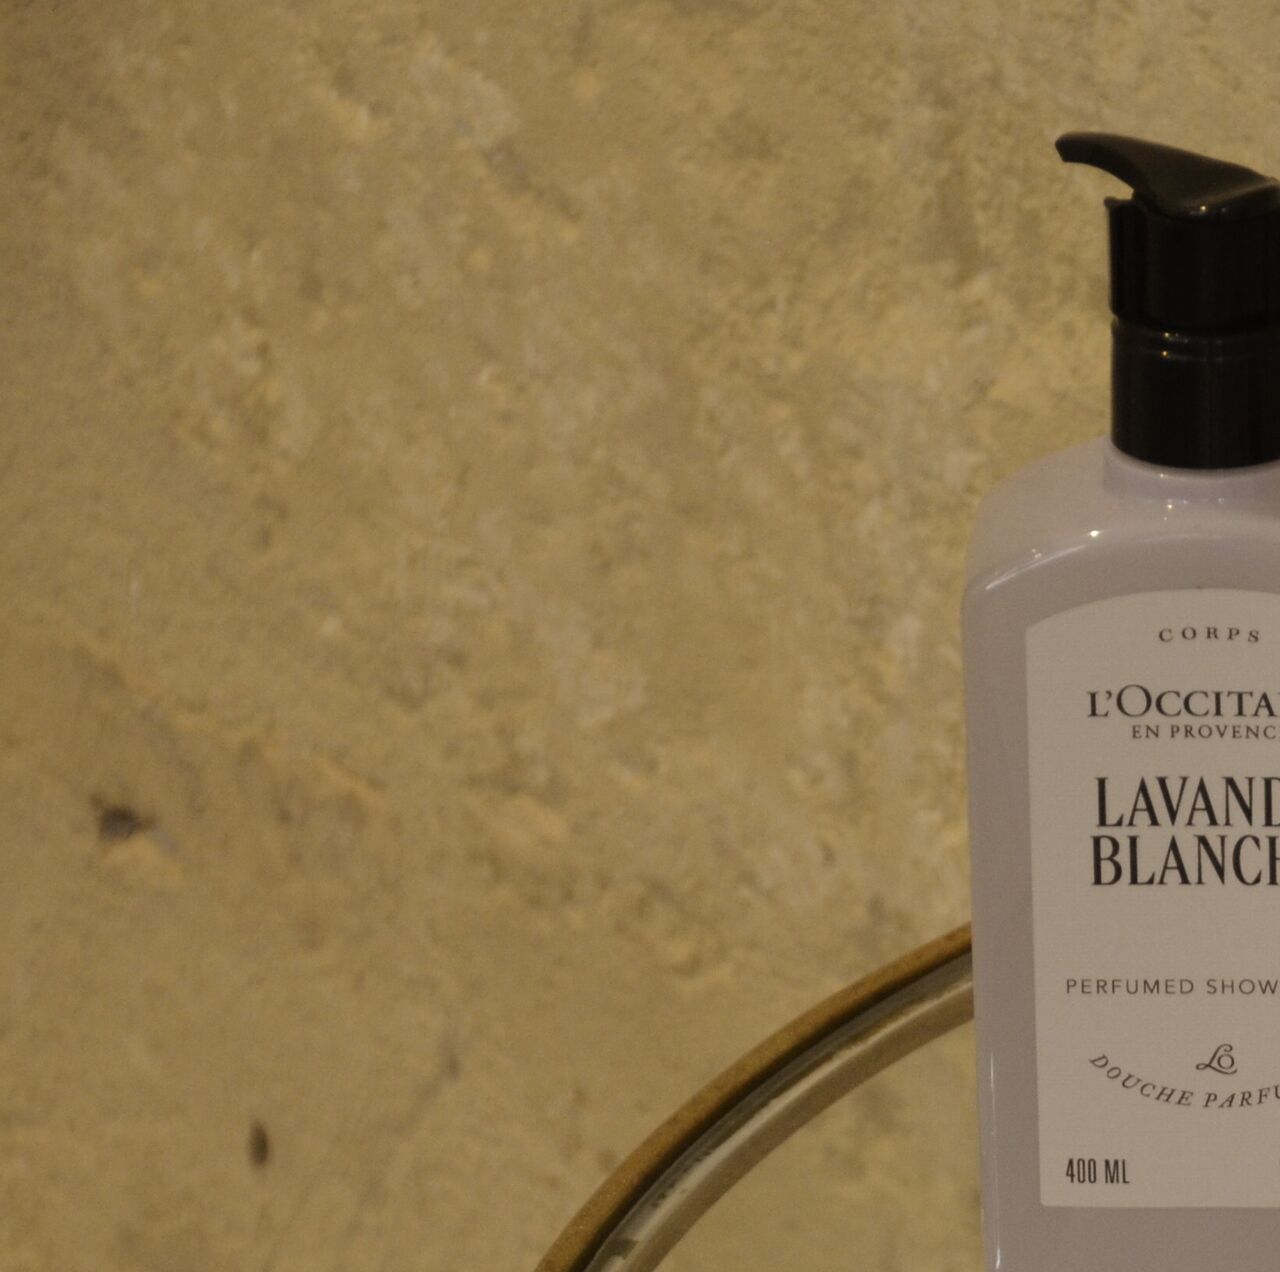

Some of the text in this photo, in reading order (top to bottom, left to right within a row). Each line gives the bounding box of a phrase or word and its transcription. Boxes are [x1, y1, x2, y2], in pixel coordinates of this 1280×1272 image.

[1158, 626, 1260, 643] CORPS
[1131, 724, 1160, 740] EN
[1066, 979, 1194, 995] PERFUMED
[1088, 1053, 1194, 1107] DOUCHE
[1066, 1158, 1130, 1184] 400 ML
